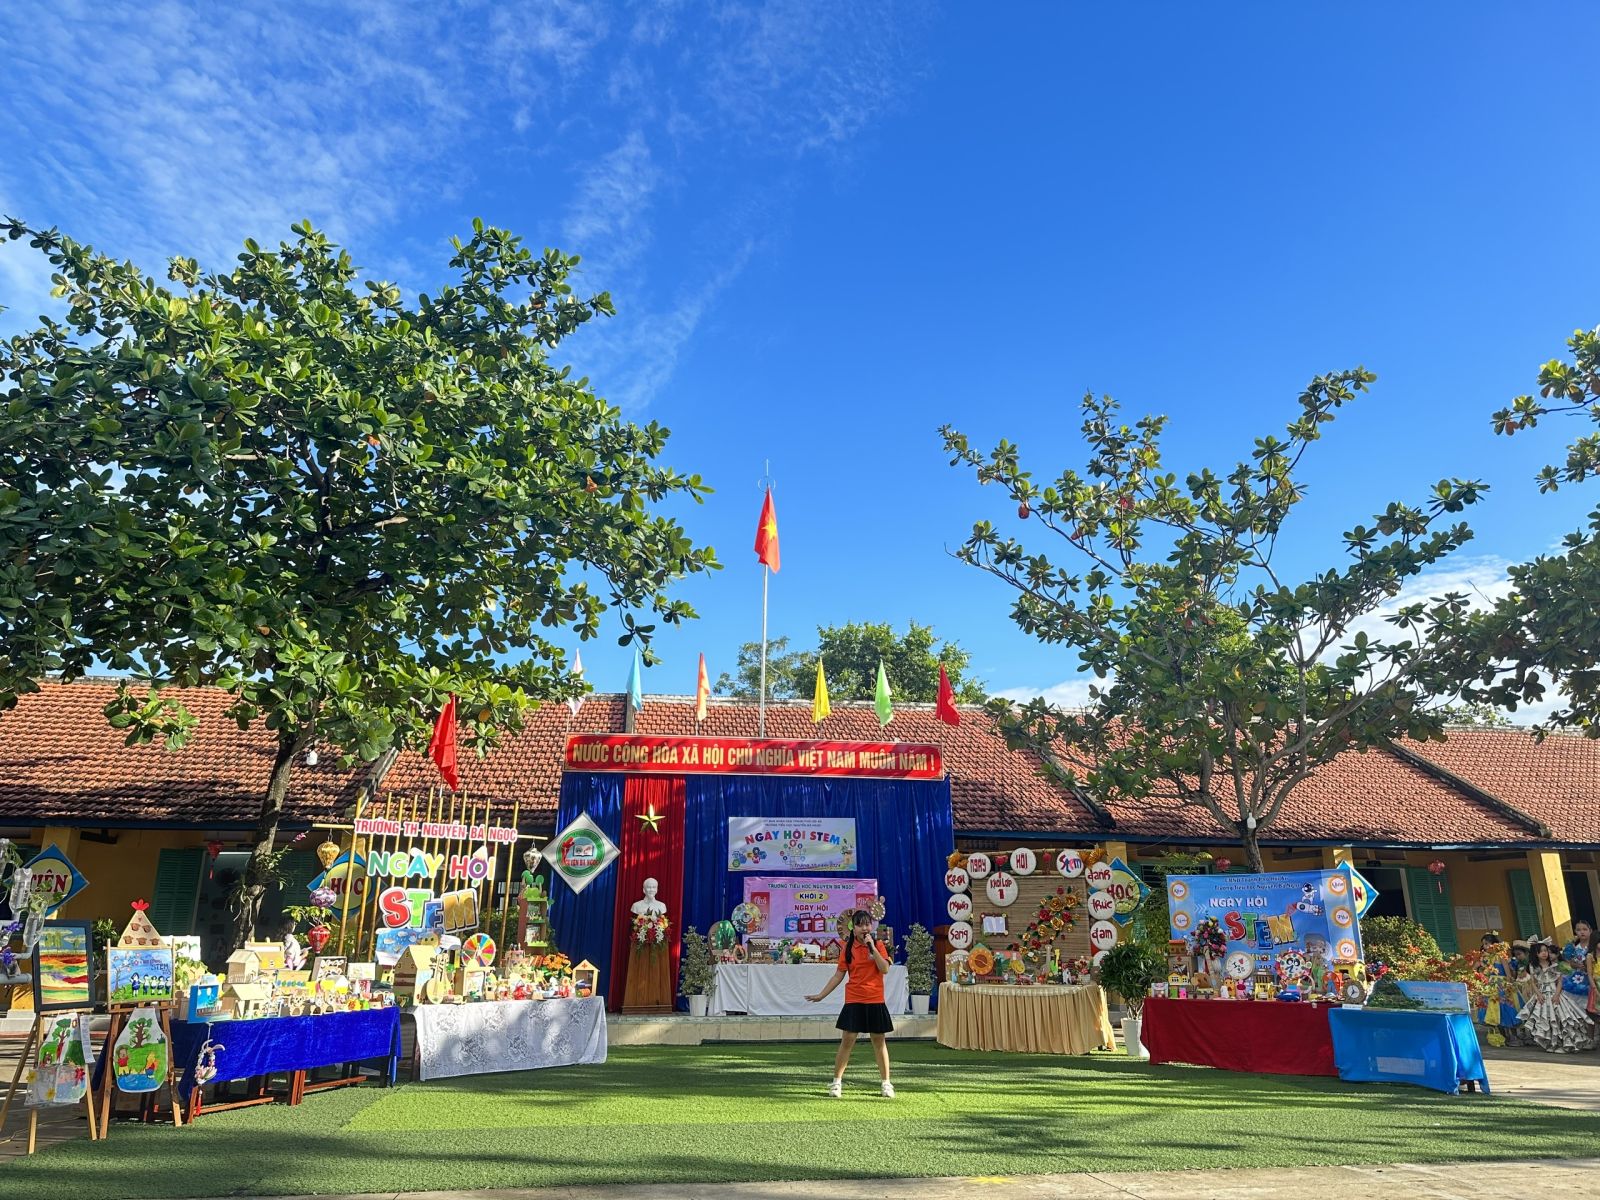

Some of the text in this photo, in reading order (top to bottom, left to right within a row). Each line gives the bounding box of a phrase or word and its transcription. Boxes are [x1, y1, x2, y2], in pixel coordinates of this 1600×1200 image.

[572, 741, 935, 771] NƯỚC CỘNG HÒA XÃ HỘI CHỦ NGHĨA VIỆT NAM MUÔN NĂM !
[355, 818, 518, 844] TRƯỜNG TH NGUYỄN BÁ NGỌC
[745, 829, 840, 845] NGÀY HỘI STEM
[368, 846, 496, 888] NGÀY HỘI
[380, 887, 480, 934] STEM
[1209, 895, 1268, 909] NGÀY HỘI
[786, 919, 838, 932] STEM
[1224, 911, 1297, 950] STEM
